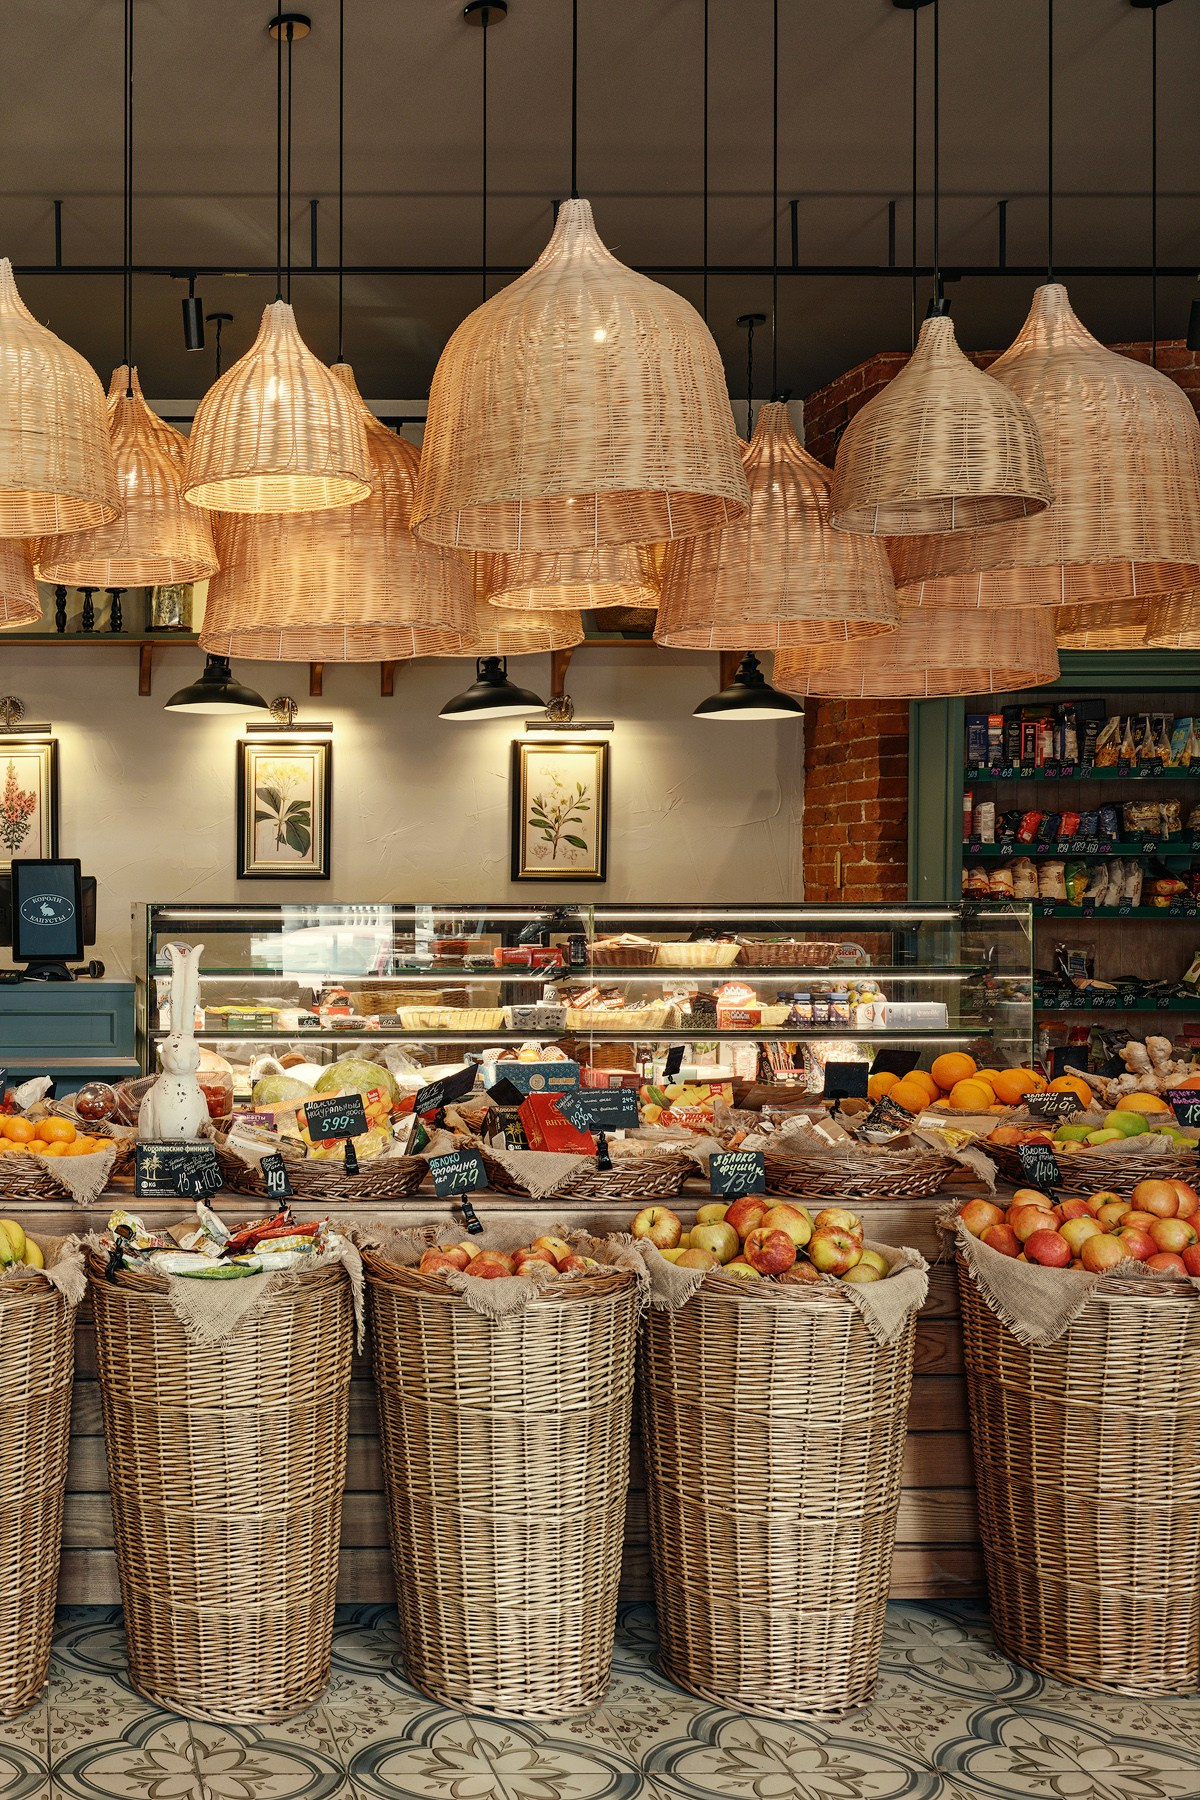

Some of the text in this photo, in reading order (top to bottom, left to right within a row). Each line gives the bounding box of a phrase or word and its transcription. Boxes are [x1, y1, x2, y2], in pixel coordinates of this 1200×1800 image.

[31, 896, 62, 904] КОРОЛИ
[29, 914, 66, 924] КАПУСТЫ
[184, 1145, 210, 1153] финики
[429, 1152, 460, 1170] ЯБЛОКО
[713, 1153, 757, 1167] ЯБЛОКО
[267, 1170, 286, 1192] 49
